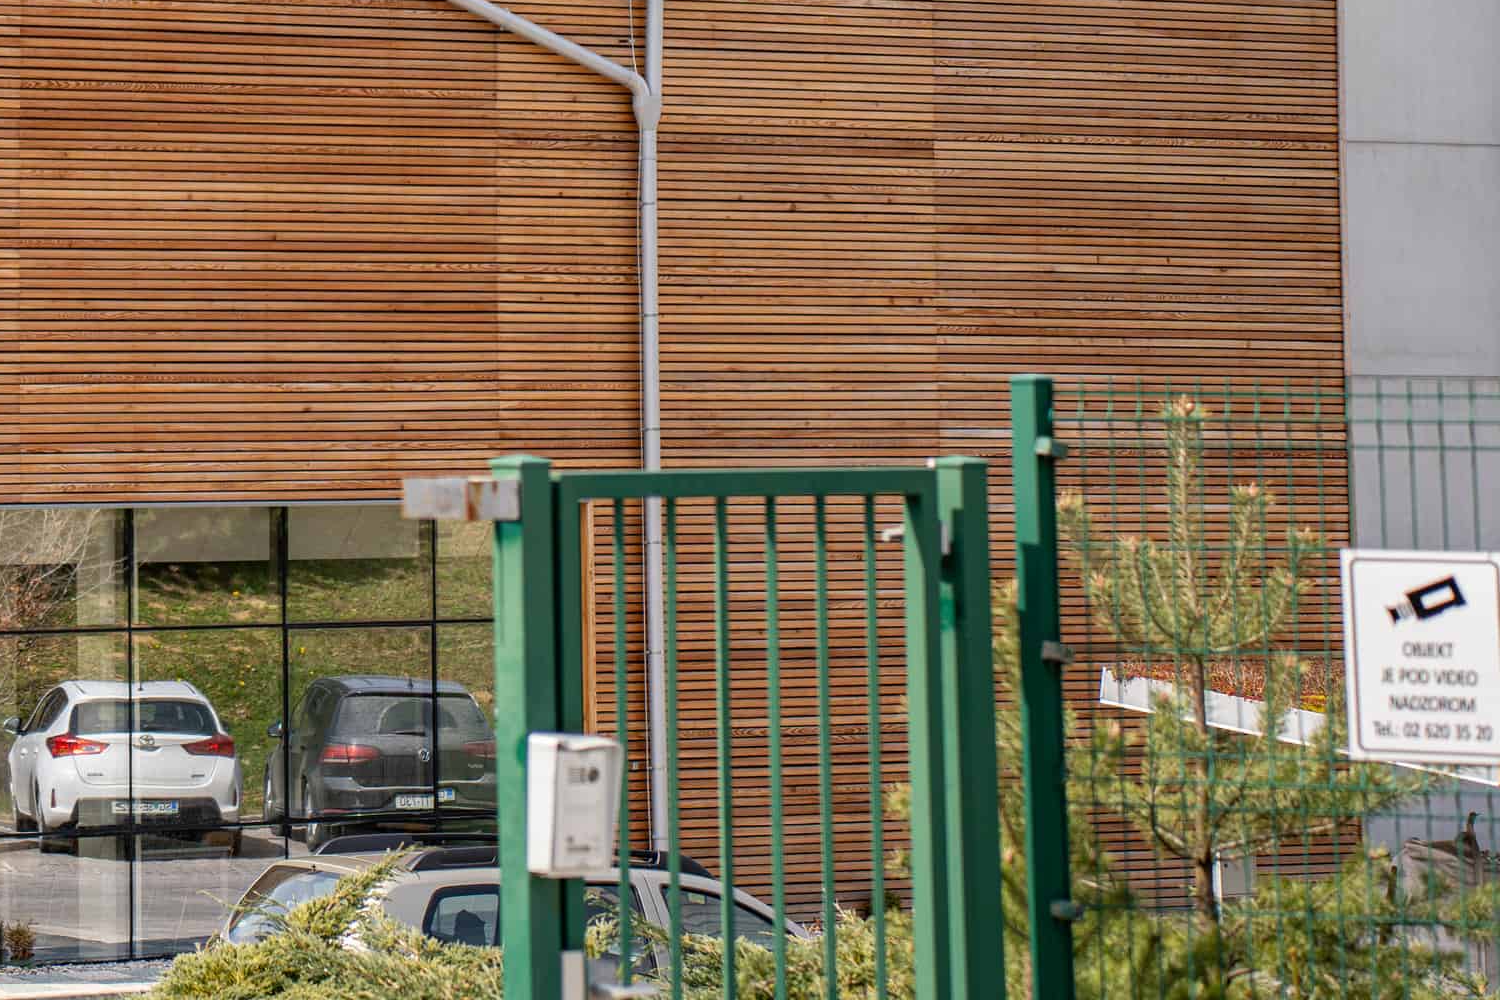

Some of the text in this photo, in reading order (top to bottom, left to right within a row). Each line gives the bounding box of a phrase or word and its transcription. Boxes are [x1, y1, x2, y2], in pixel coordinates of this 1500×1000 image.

[1402, 641, 1454, 658] OBJEKT
[1381, 667, 1478, 687] JE POD VIDEO
[1388, 694, 1477, 713] NADZOROM
[1403, 722, 1420, 738] 02
[1476, 725, 1493, 741] 20
